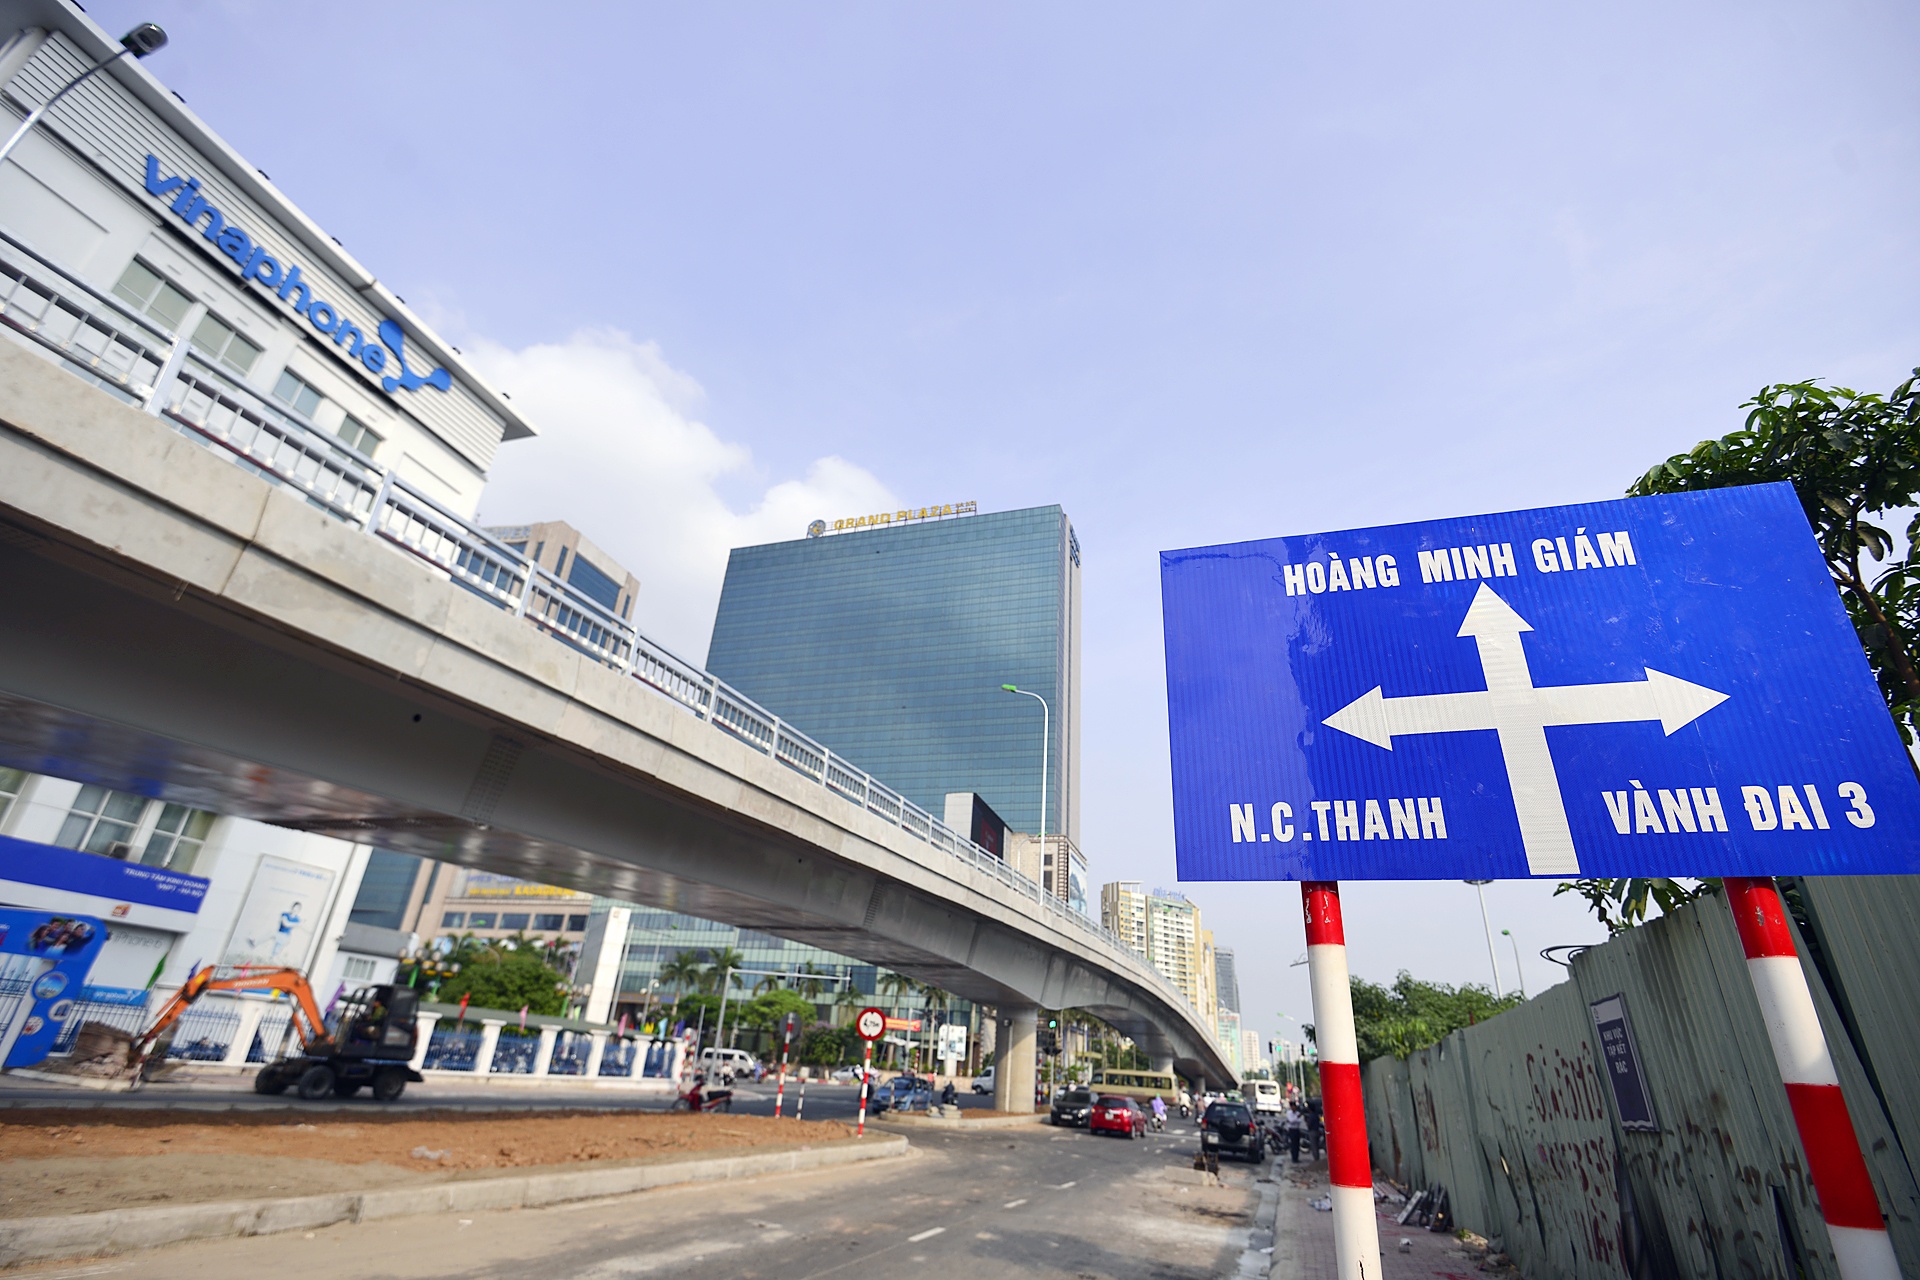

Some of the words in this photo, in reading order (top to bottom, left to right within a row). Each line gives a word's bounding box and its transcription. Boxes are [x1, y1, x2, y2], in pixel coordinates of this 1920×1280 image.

[145, 154, 387, 373] vinaphone
[834, 513, 891, 531] GRAND
[896, 504, 953, 521] PLAZA
[1283, 552, 1400, 597] HOÀNG
[1418, 543, 1518, 584] MINH
[1532, 527, 1637, 574] GIÁM
[1602, 779, 1729, 835] VÀNH
[1741, 785, 1831, 831] ĐAI
[1838, 781, 1876, 829] 3
[1603, 1030, 1613, 1041] KHU
[1615, 1058, 1628, 1074] RÁC
